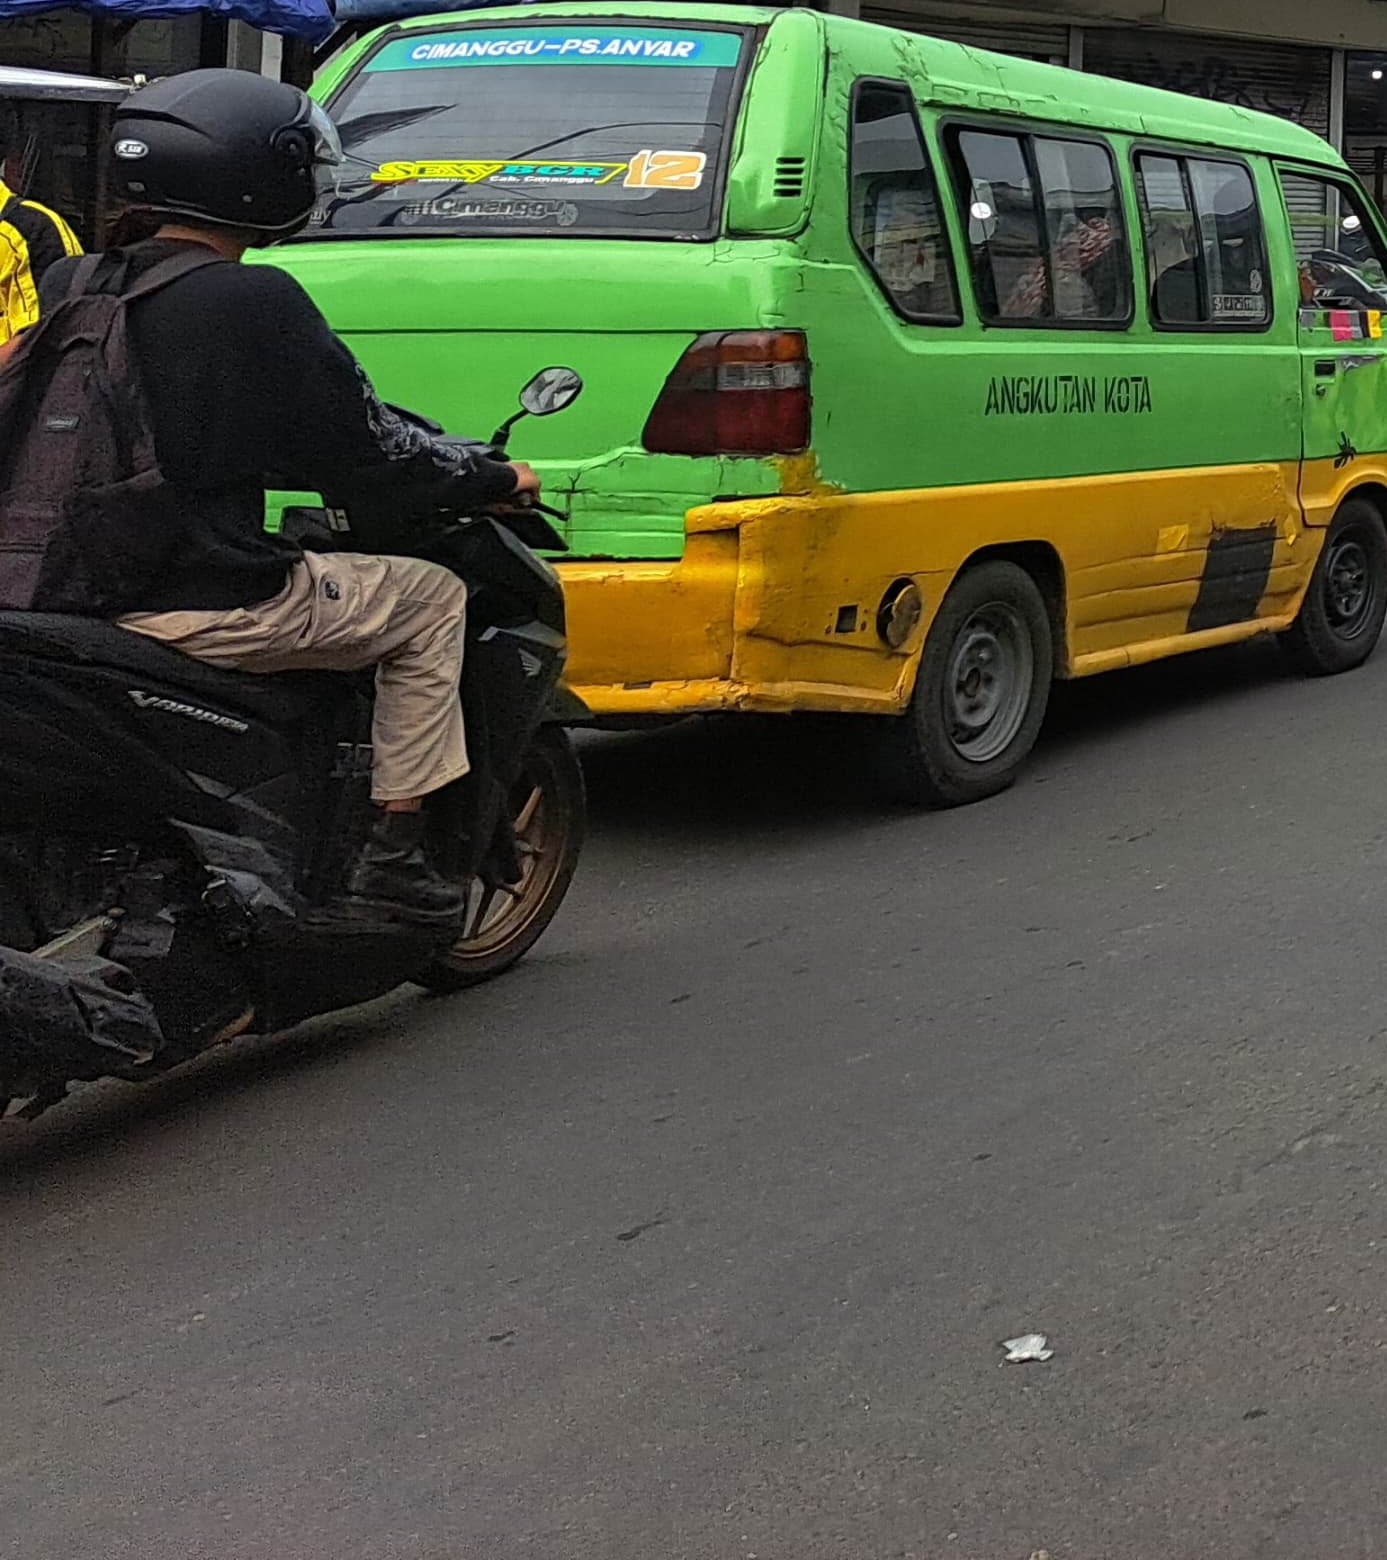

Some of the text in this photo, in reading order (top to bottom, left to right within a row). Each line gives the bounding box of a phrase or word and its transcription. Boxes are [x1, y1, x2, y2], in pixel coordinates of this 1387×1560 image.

[502, 164, 605, 176] BGR
[622, 150, 707, 190] 12
[985, 376, 1152, 416] ANGKUTAN KOTA
